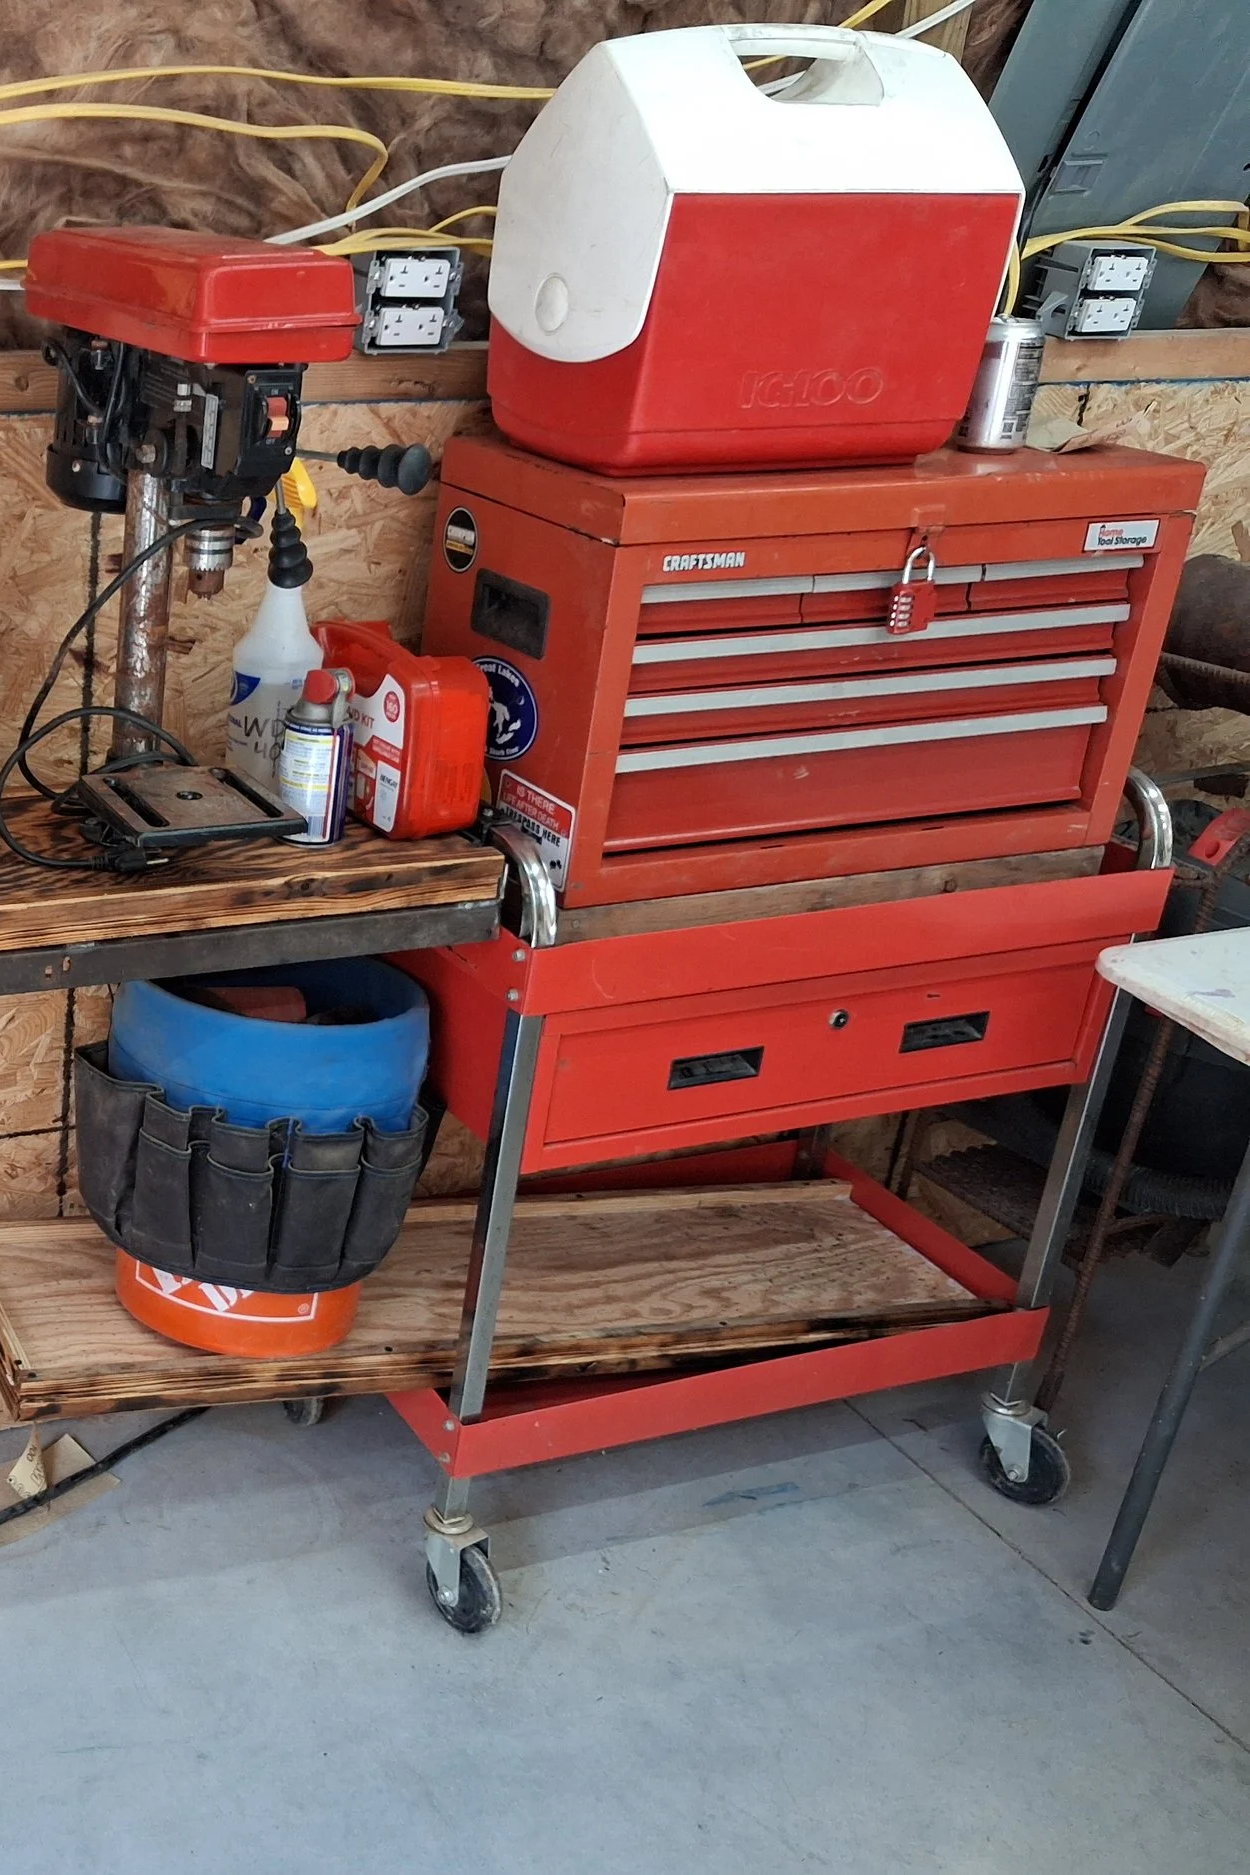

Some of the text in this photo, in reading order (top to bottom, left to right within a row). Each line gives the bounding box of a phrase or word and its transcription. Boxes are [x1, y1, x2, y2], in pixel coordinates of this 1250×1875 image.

[738, 367, 885, 408] IGLOO
[1098, 536, 1147, 546] Tool Storage
[1099, 525, 1124, 537] Home
[662, 551, 746, 572] CRAFTSMAN
[476, 663, 520, 688] reat Lakes
[361, 712, 375, 729] KIT
[503, 792, 559, 831] LIFE AFTER DEATH
[516, 785, 556, 816] IS THERE
[506, 807, 540, 834] TRESPASS
[542, 828, 561, 847] HERE
